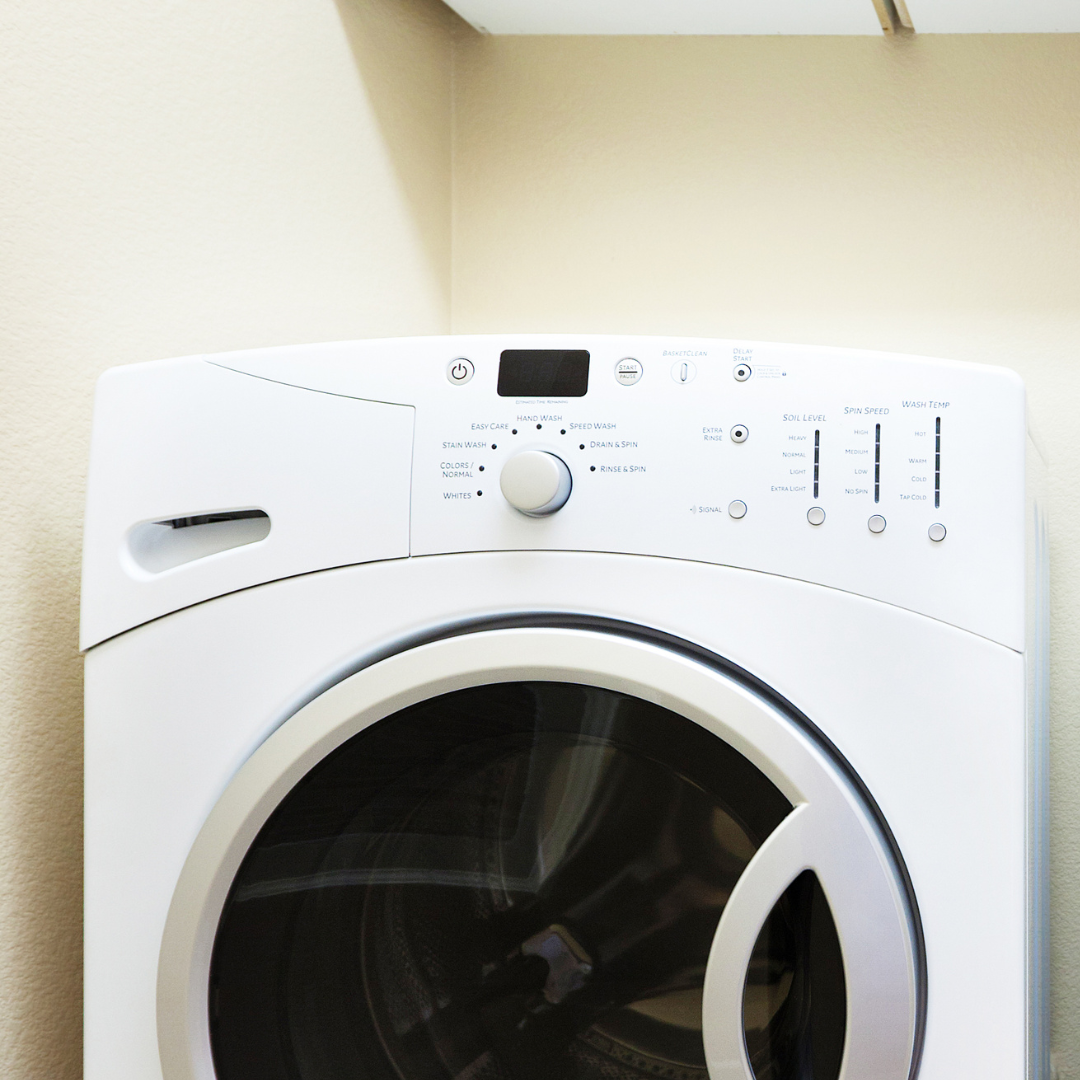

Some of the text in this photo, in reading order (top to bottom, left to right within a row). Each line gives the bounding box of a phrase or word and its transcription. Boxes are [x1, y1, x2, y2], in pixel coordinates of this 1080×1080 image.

[902, 400, 950, 409] WASH TEMP
[844, 407, 889, 415] SPIN SPEED
[783, 414, 826, 422] SOIL LEVEL
